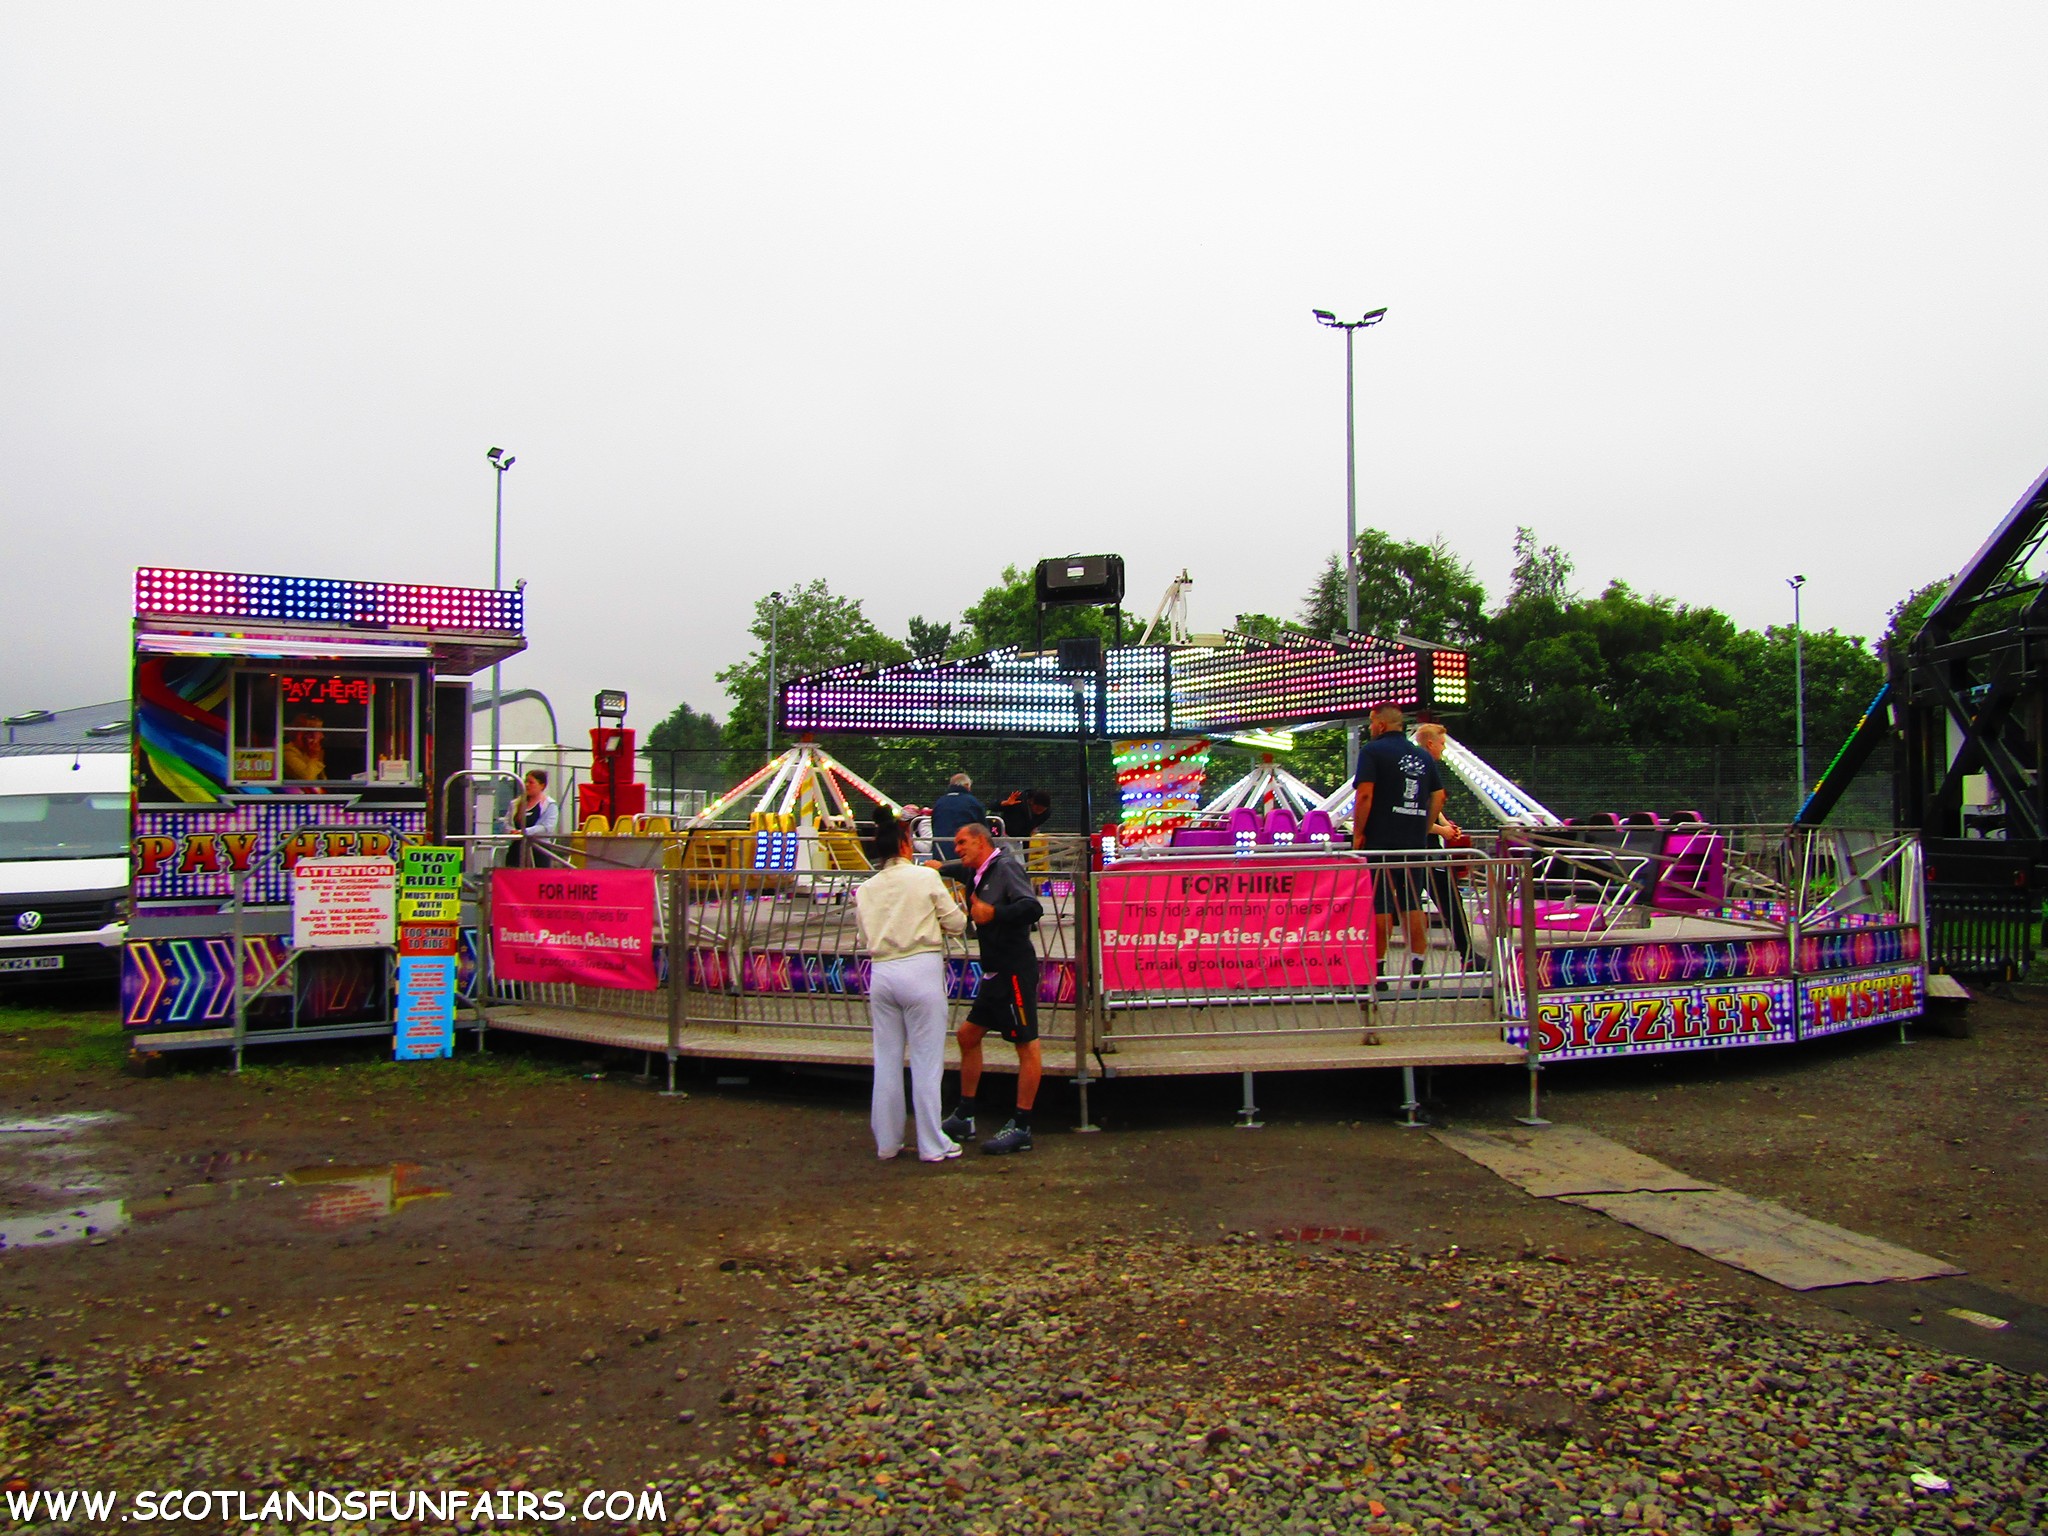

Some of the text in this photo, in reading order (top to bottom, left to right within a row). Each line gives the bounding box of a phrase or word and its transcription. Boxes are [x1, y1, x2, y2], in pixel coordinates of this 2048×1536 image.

[283, 678, 314, 697] PAY
[137, 832, 258, 876] PAY
[409, 852, 455, 863] OKAY
[300, 866, 391, 876] ATTENTION
[421, 864, 442, 874] TO
[405, 876, 446, 886] RIDE
[1181, 875, 1294, 895] FOR HIRE
[538, 884, 598, 900] FOR HIRE
[1126, 903, 1157, 917] This
[1195, 903, 1224, 916] and
[1229, 904, 1269, 919] many
[405, 928, 452, 937] TOO SMALL
[1336, 926, 1369, 941] etc
[409, 939, 419, 948] TO
[423, 939, 442, 948] RIDE
[621, 936, 640, 949] etc
[1537, 973, 1915, 1052] SIZZLER TWISTER
